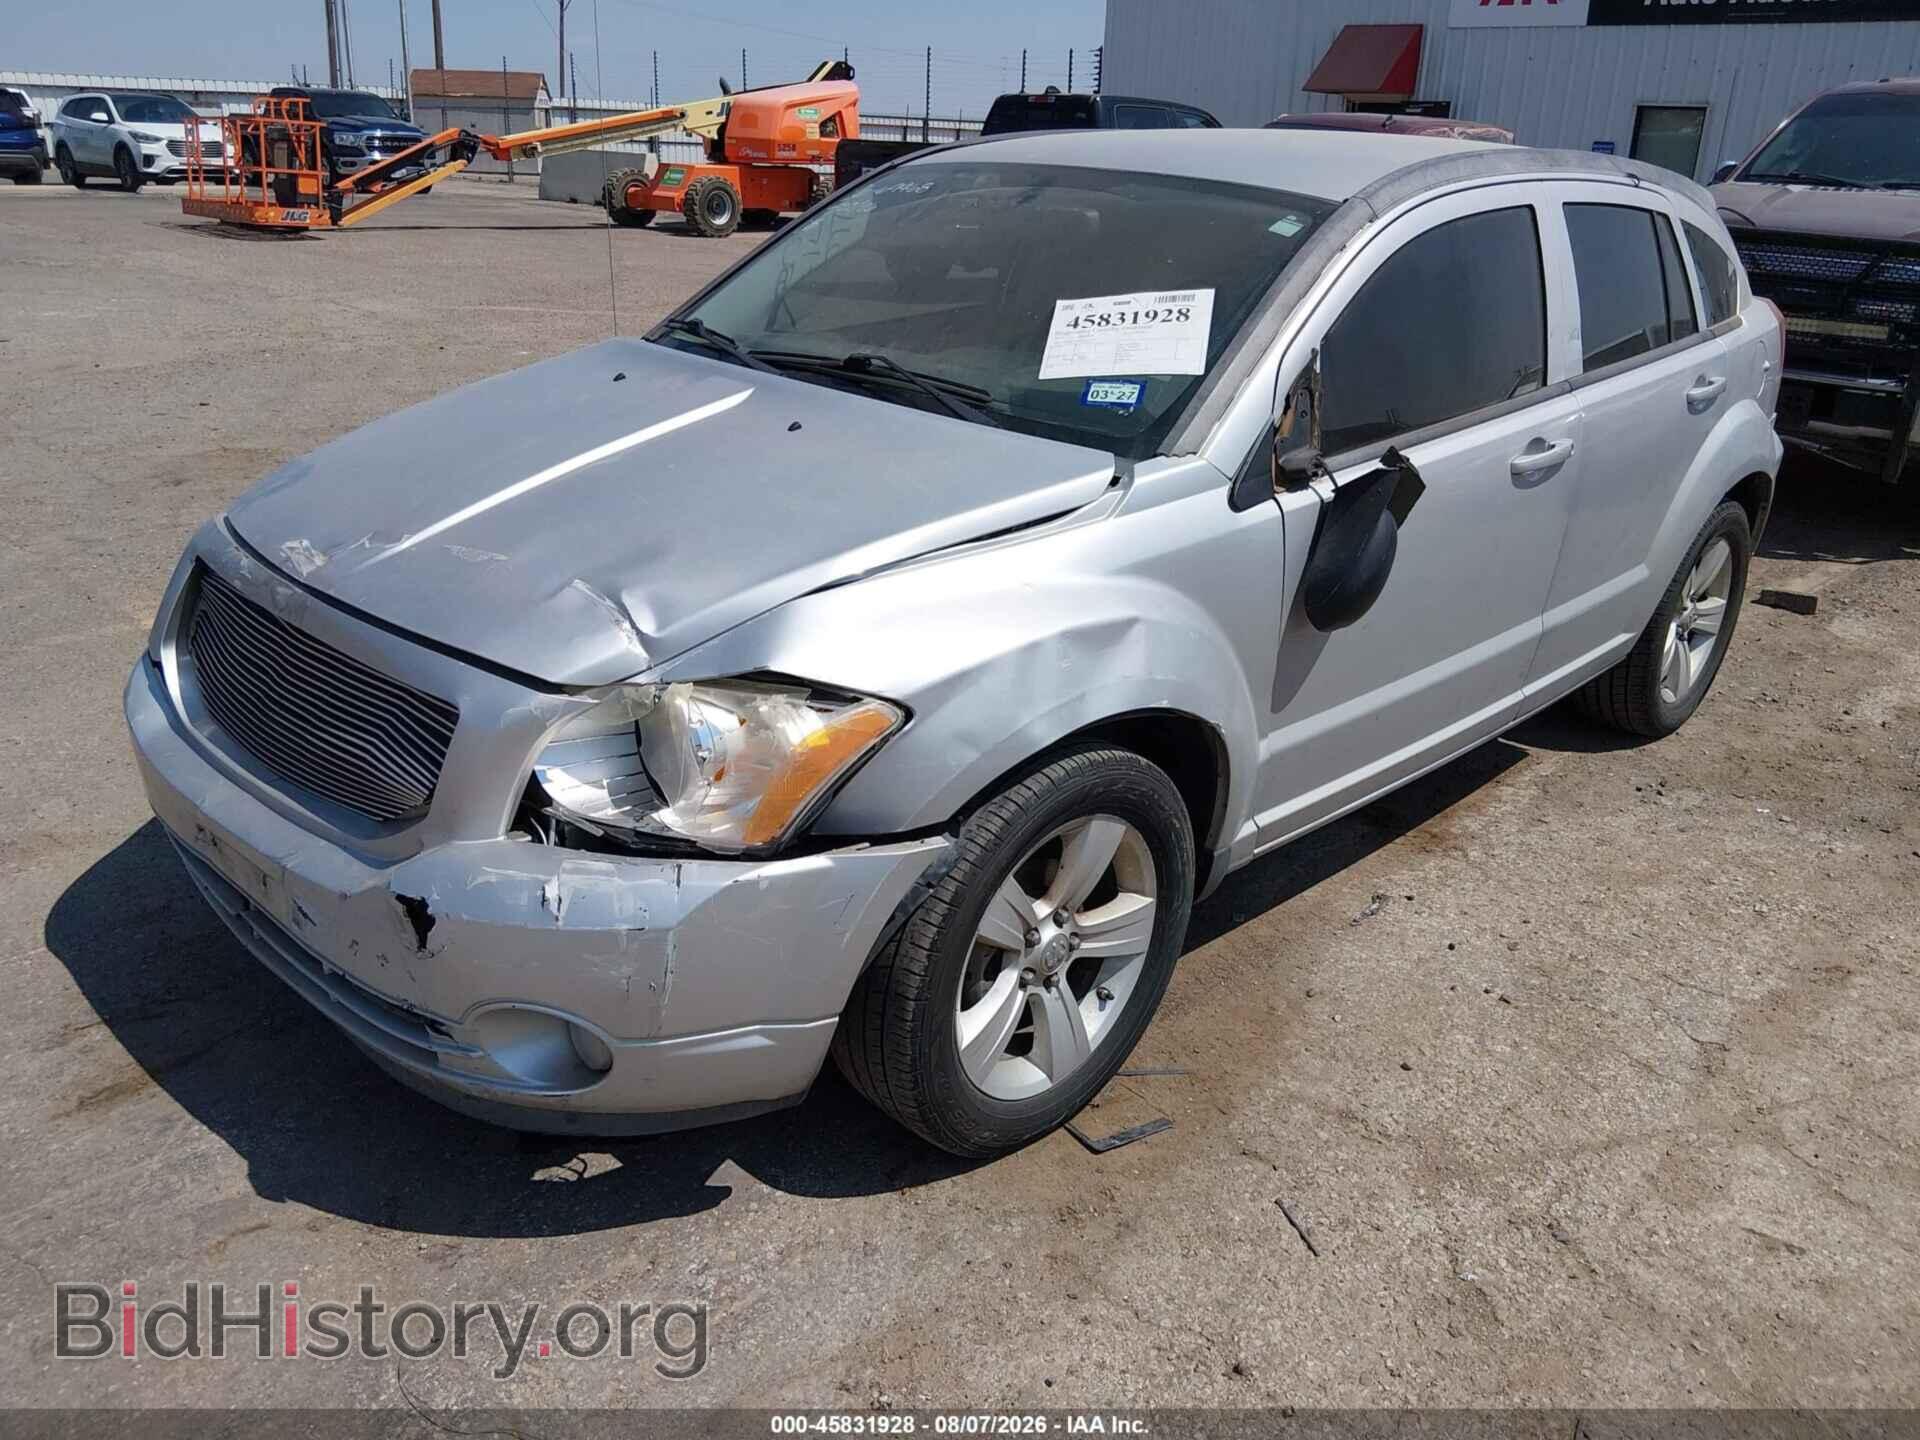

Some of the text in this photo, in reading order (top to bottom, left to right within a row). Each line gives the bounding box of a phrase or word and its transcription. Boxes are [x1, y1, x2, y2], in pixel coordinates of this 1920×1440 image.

[1066, 307, 1191, 329] 45831928
[1090, 389, 1109, 400] 03
[1116, 390, 1136, 401] 27
